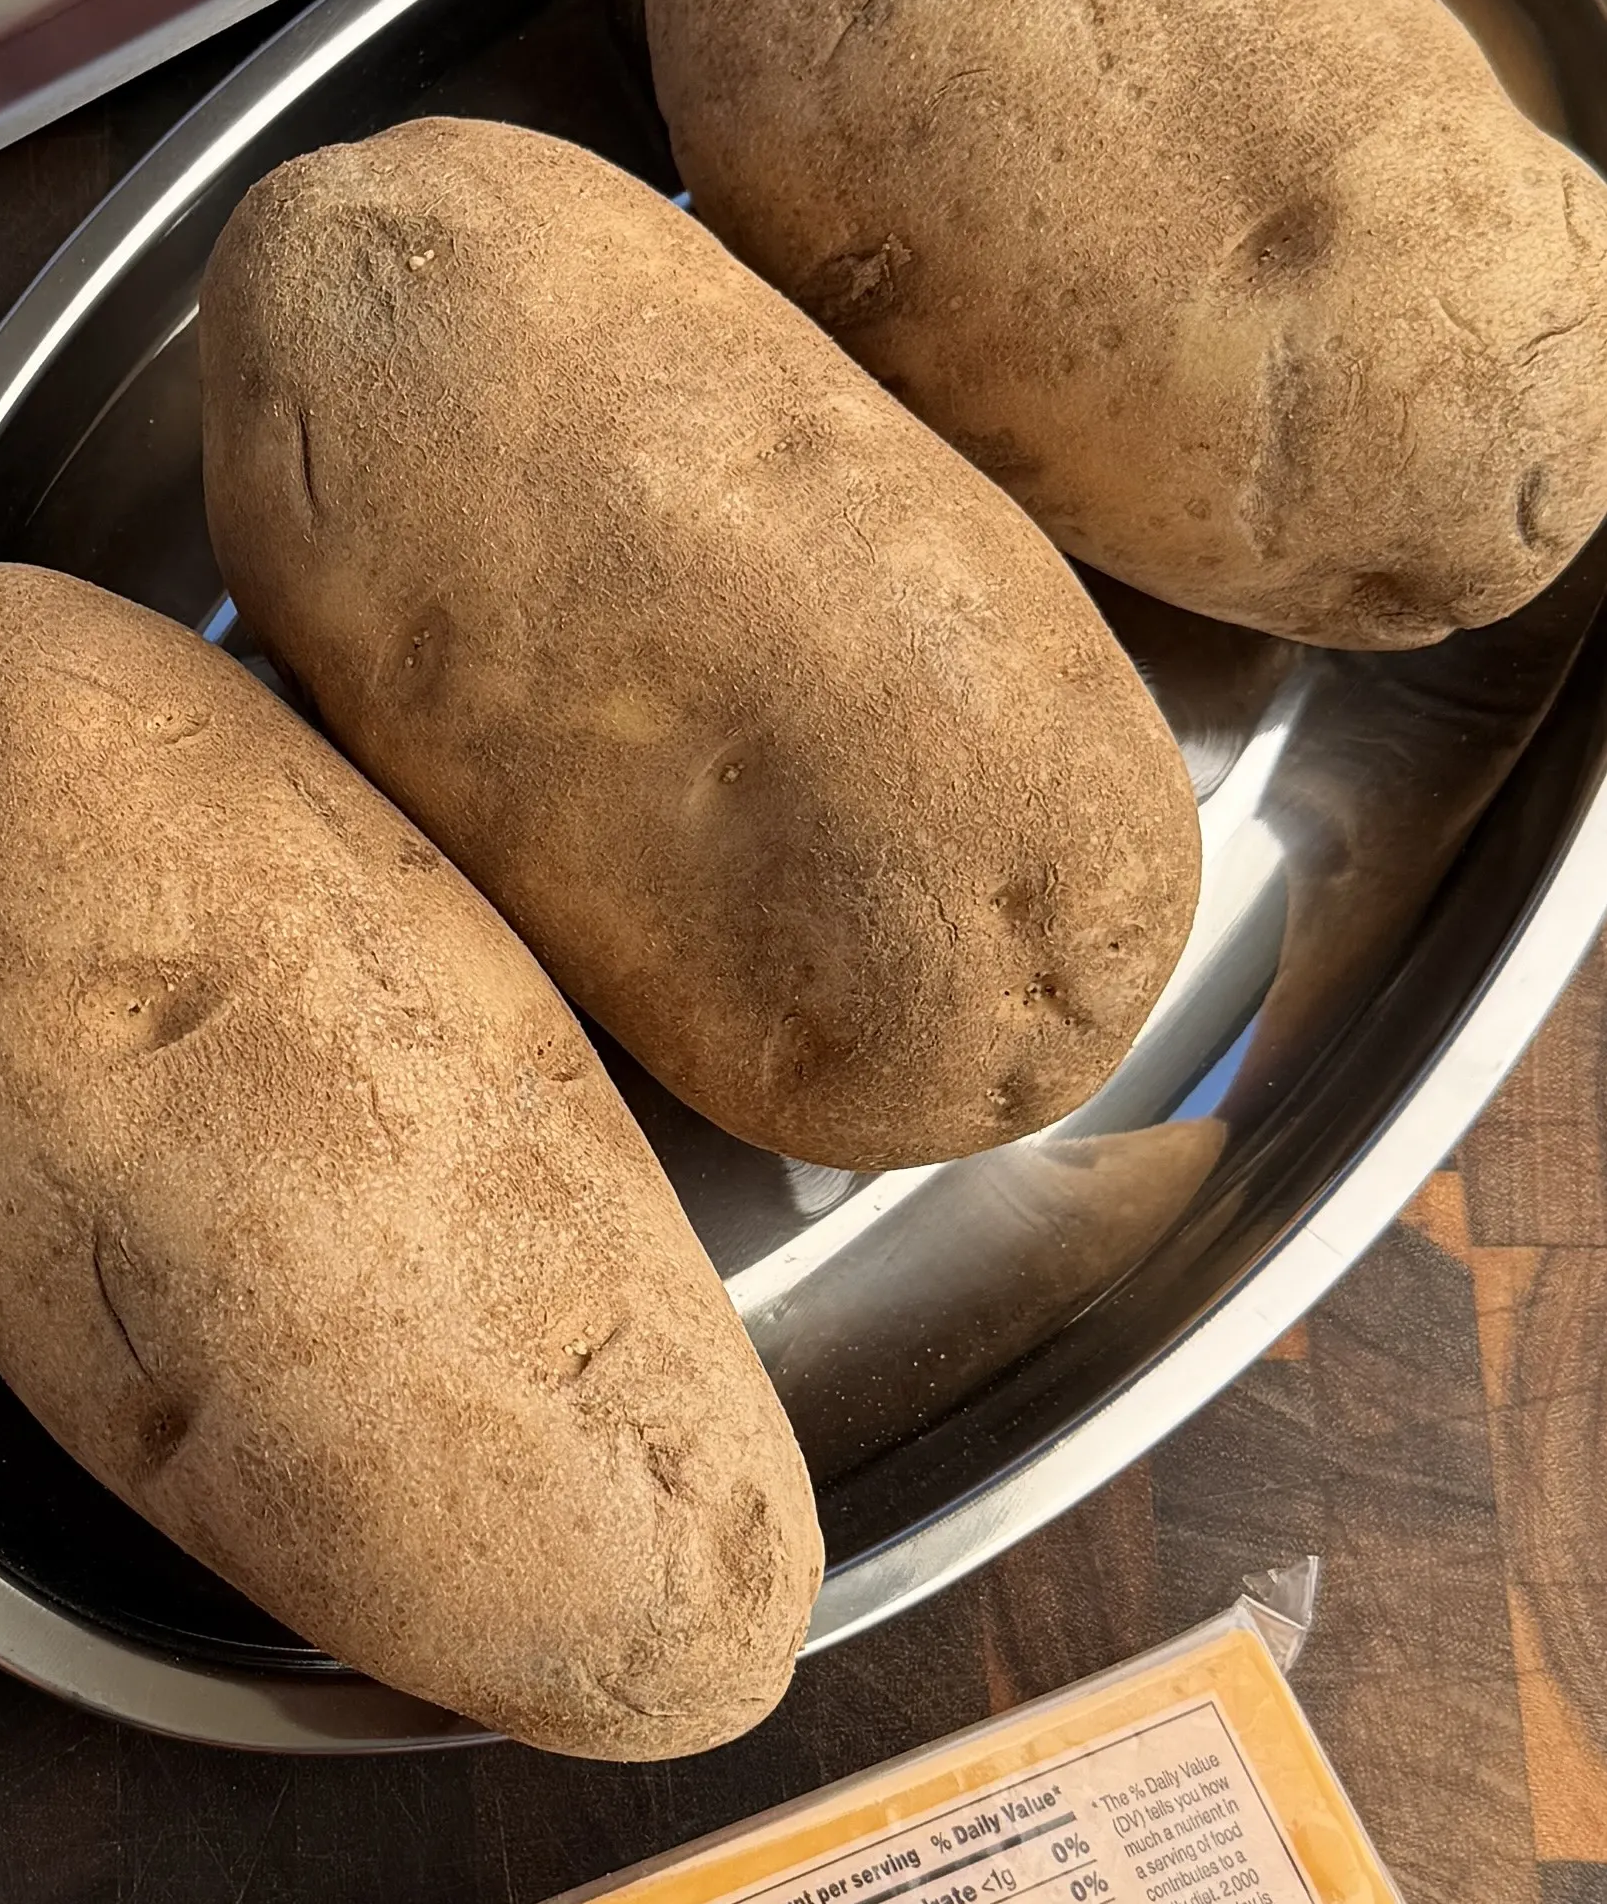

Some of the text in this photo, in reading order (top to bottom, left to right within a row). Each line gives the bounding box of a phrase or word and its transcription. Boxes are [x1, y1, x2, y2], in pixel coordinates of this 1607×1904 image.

[981, 1868, 1017, 1892] <1g
[1051, 1832, 1090, 1863] 0%
[1070, 1870, 1109, 1902] 0%
[1218, 1867, 1260, 1897] 2,000
